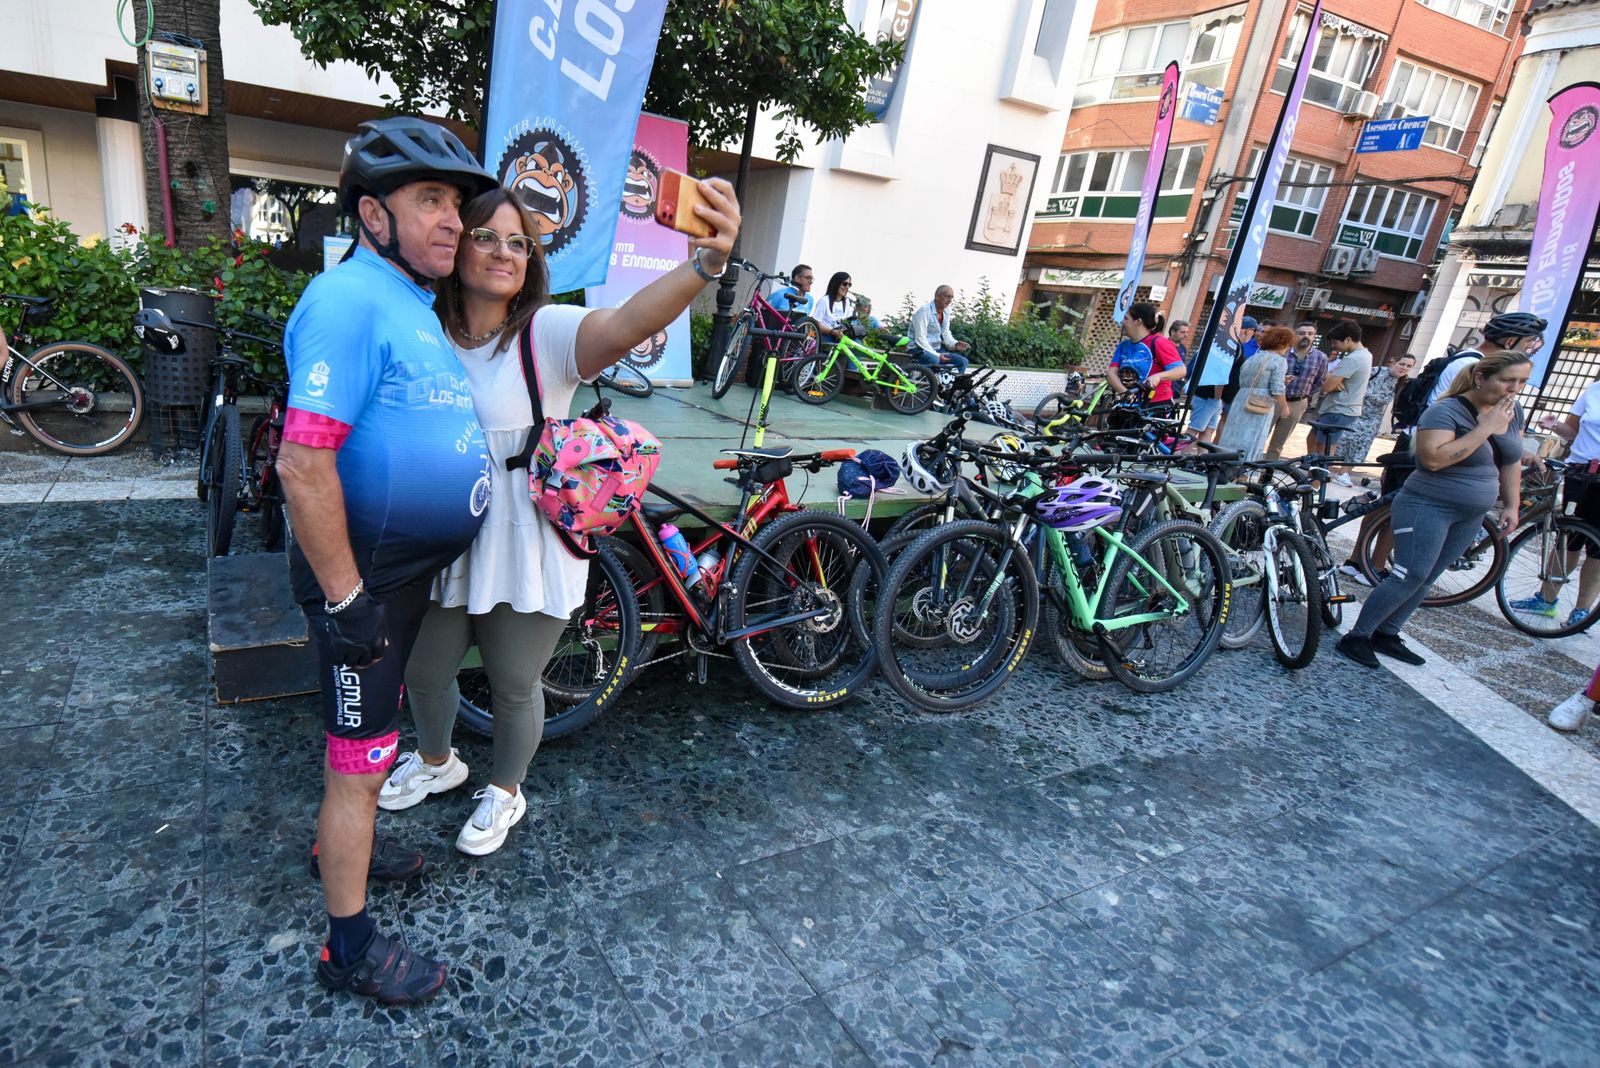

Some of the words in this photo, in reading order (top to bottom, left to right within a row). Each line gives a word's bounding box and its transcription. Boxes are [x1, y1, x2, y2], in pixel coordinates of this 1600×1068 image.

[560, 0, 635, 102] LO
[503, 118, 530, 147] MTB
[534, 116, 557, 129] LOS
[1365, 121, 1398, 133] Asesoría
[1398, 119, 1427, 130] Cuenca
[615, 242, 635, 253] MTB
[429, 389, 454, 404] LOS
[1220, 583, 1231, 624] MAXXIS
[1007, 629, 1031, 672] MAXXIS
[596, 655, 628, 706] MAXXIS
[807, 687, 847, 703] MAXXIS
